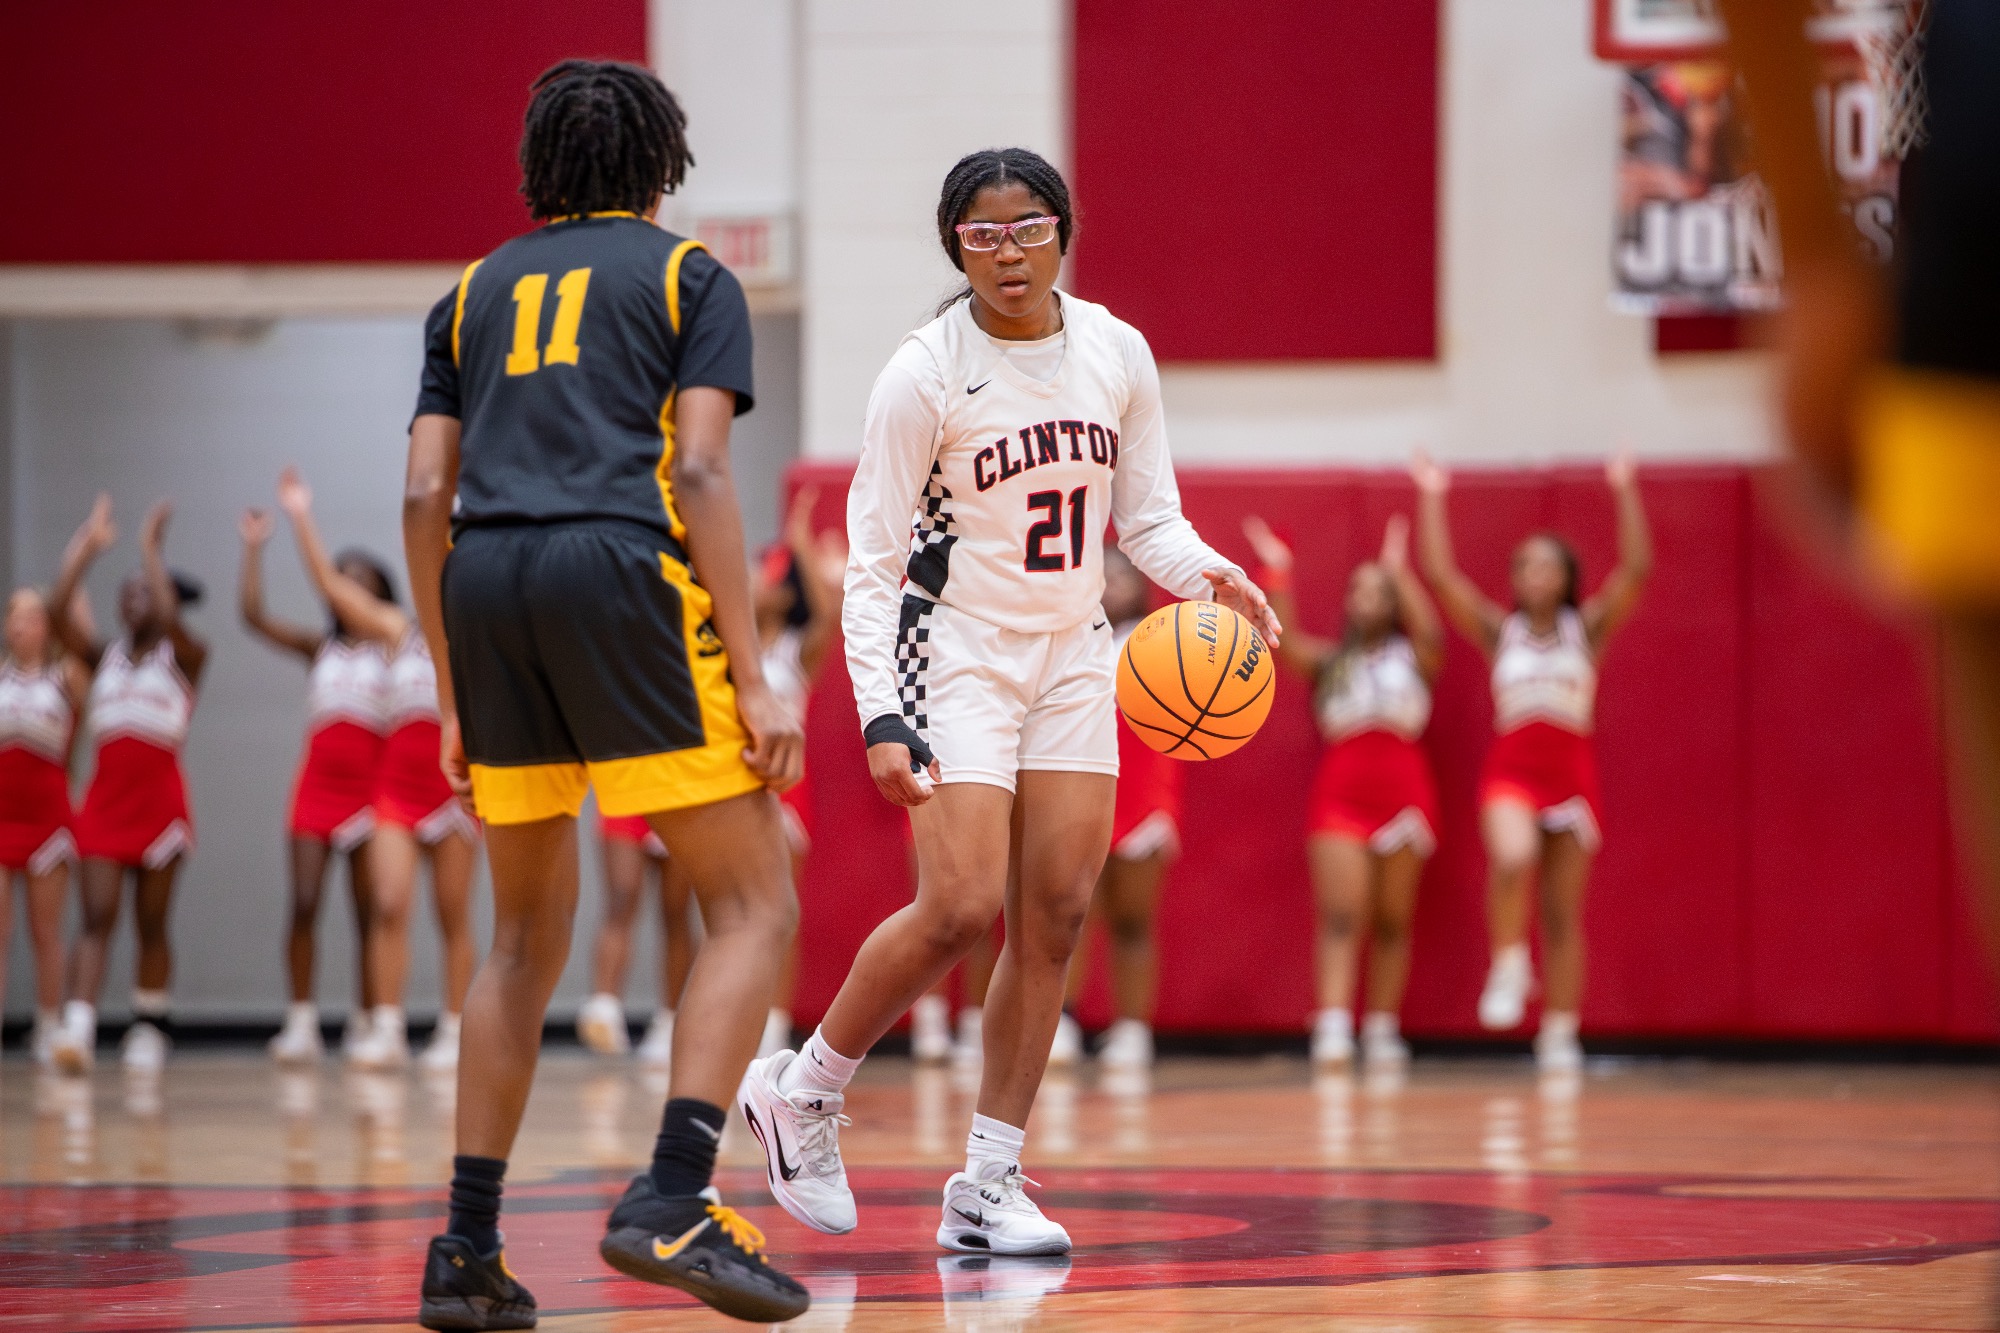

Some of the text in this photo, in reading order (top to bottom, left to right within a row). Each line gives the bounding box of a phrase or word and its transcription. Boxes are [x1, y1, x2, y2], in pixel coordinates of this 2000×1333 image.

[1621, 197, 1894, 284] JONS
[506, 267, 592, 376] 11
[973, 419, 1119, 493] CLINTON
[1024, 485, 1088, 573] 21
[1197, 602, 1218, 666] EVO NXT
[1234, 626, 1267, 682] lson
